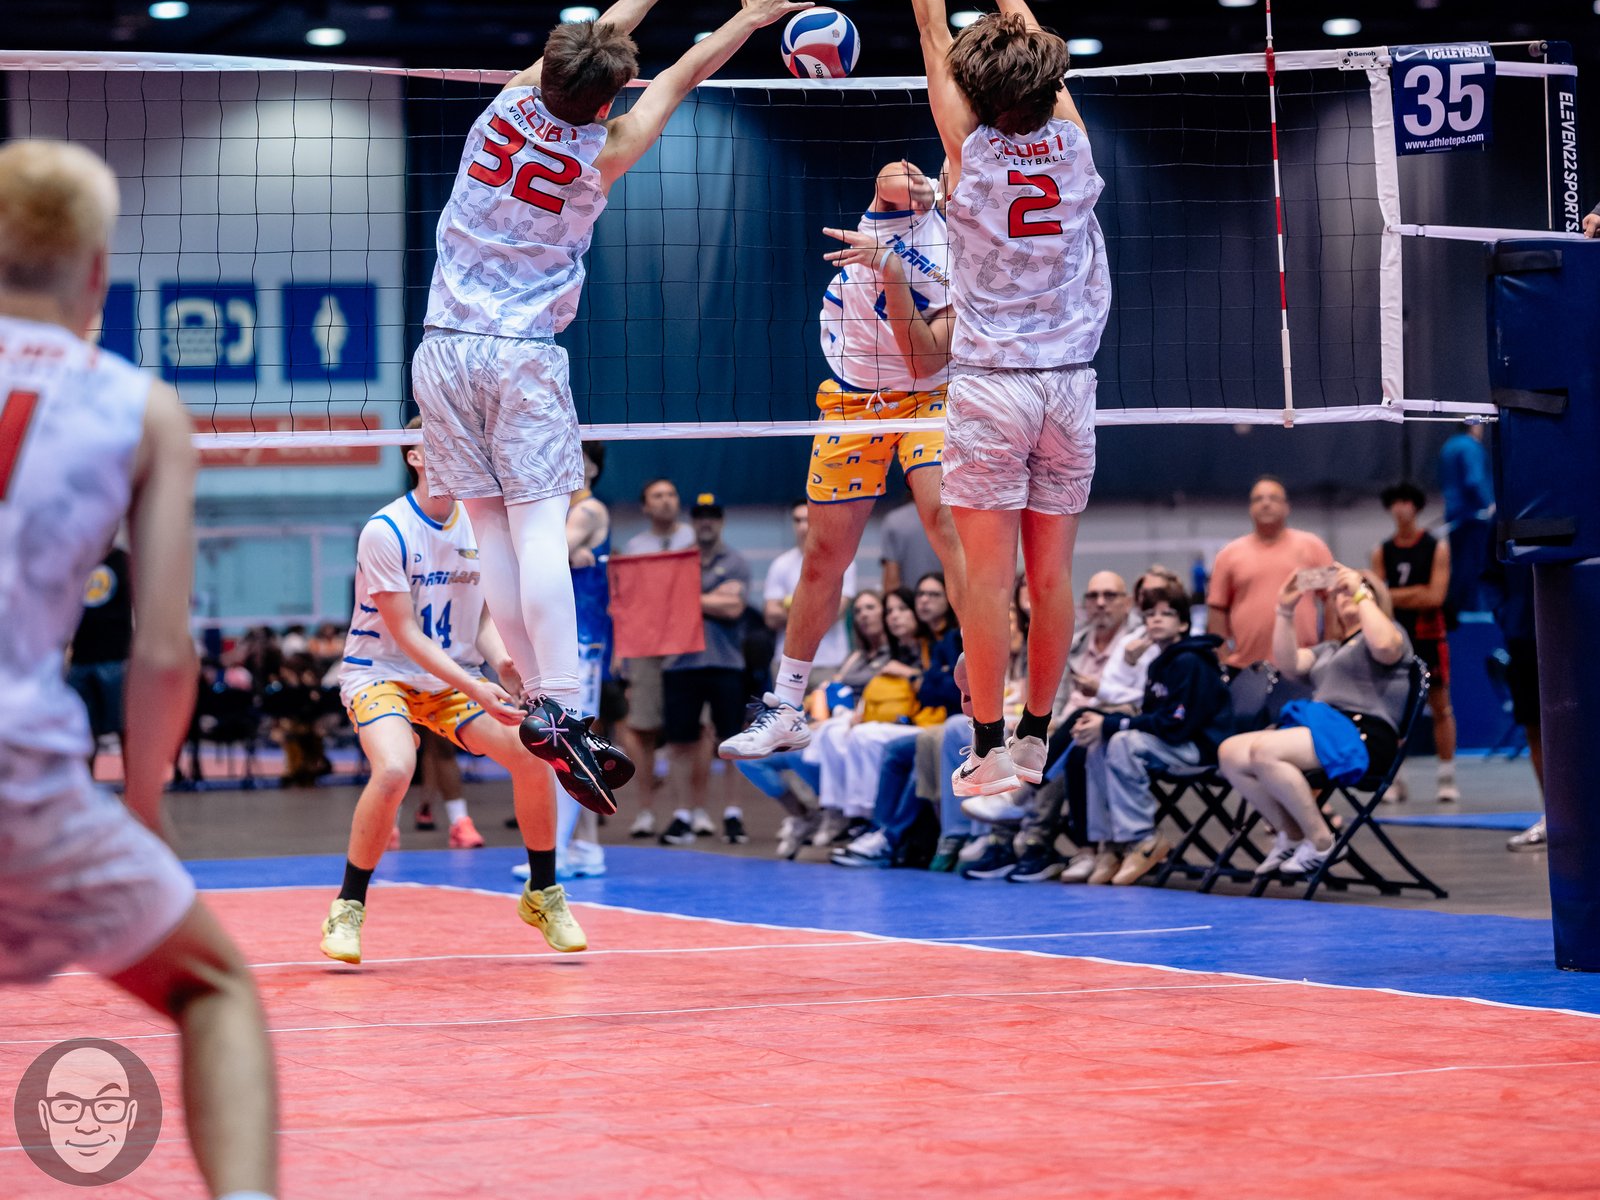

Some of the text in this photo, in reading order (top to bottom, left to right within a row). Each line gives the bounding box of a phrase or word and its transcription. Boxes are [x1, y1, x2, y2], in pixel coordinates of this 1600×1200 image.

[1425, 46, 1491, 60] VOLLEYBALL
[1403, 62, 1486, 137] 35
[467, 113, 582, 215] 32
[994, 153, 1067, 166] VLLEYBALL
[1404, 133, 1485, 150] www.athleteps.com
[1007, 170, 1064, 238] 2
[420, 599, 452, 649] 14
